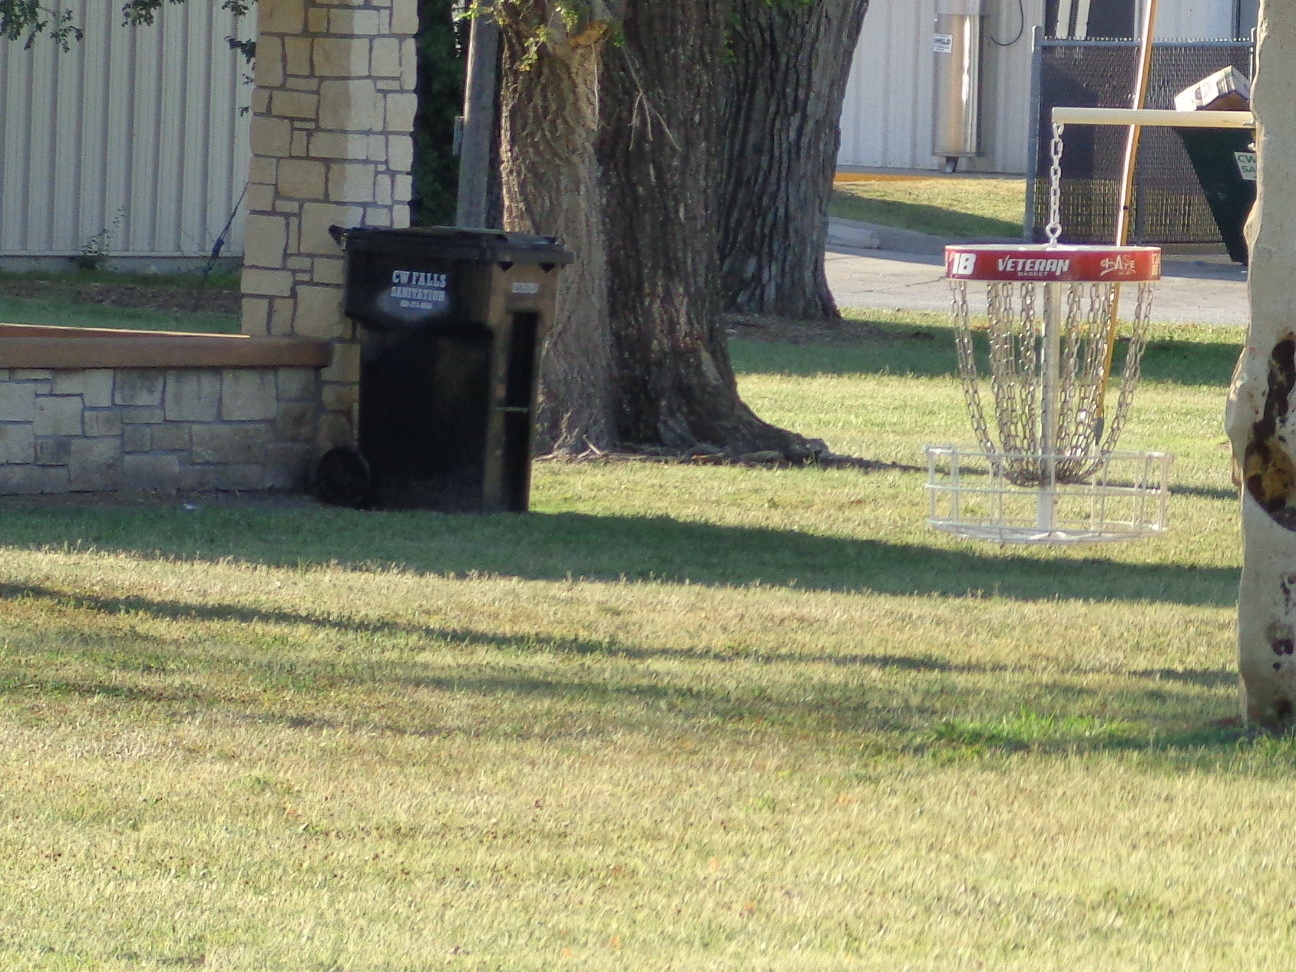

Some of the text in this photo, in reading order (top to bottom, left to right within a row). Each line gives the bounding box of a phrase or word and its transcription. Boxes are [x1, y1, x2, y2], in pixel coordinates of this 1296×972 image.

[948, 251, 977, 275] 18
[998, 255, 1070, 276] VETERAN
[392, 270, 447, 288] CW FALLS
[391, 286, 446, 302] SANITATION
